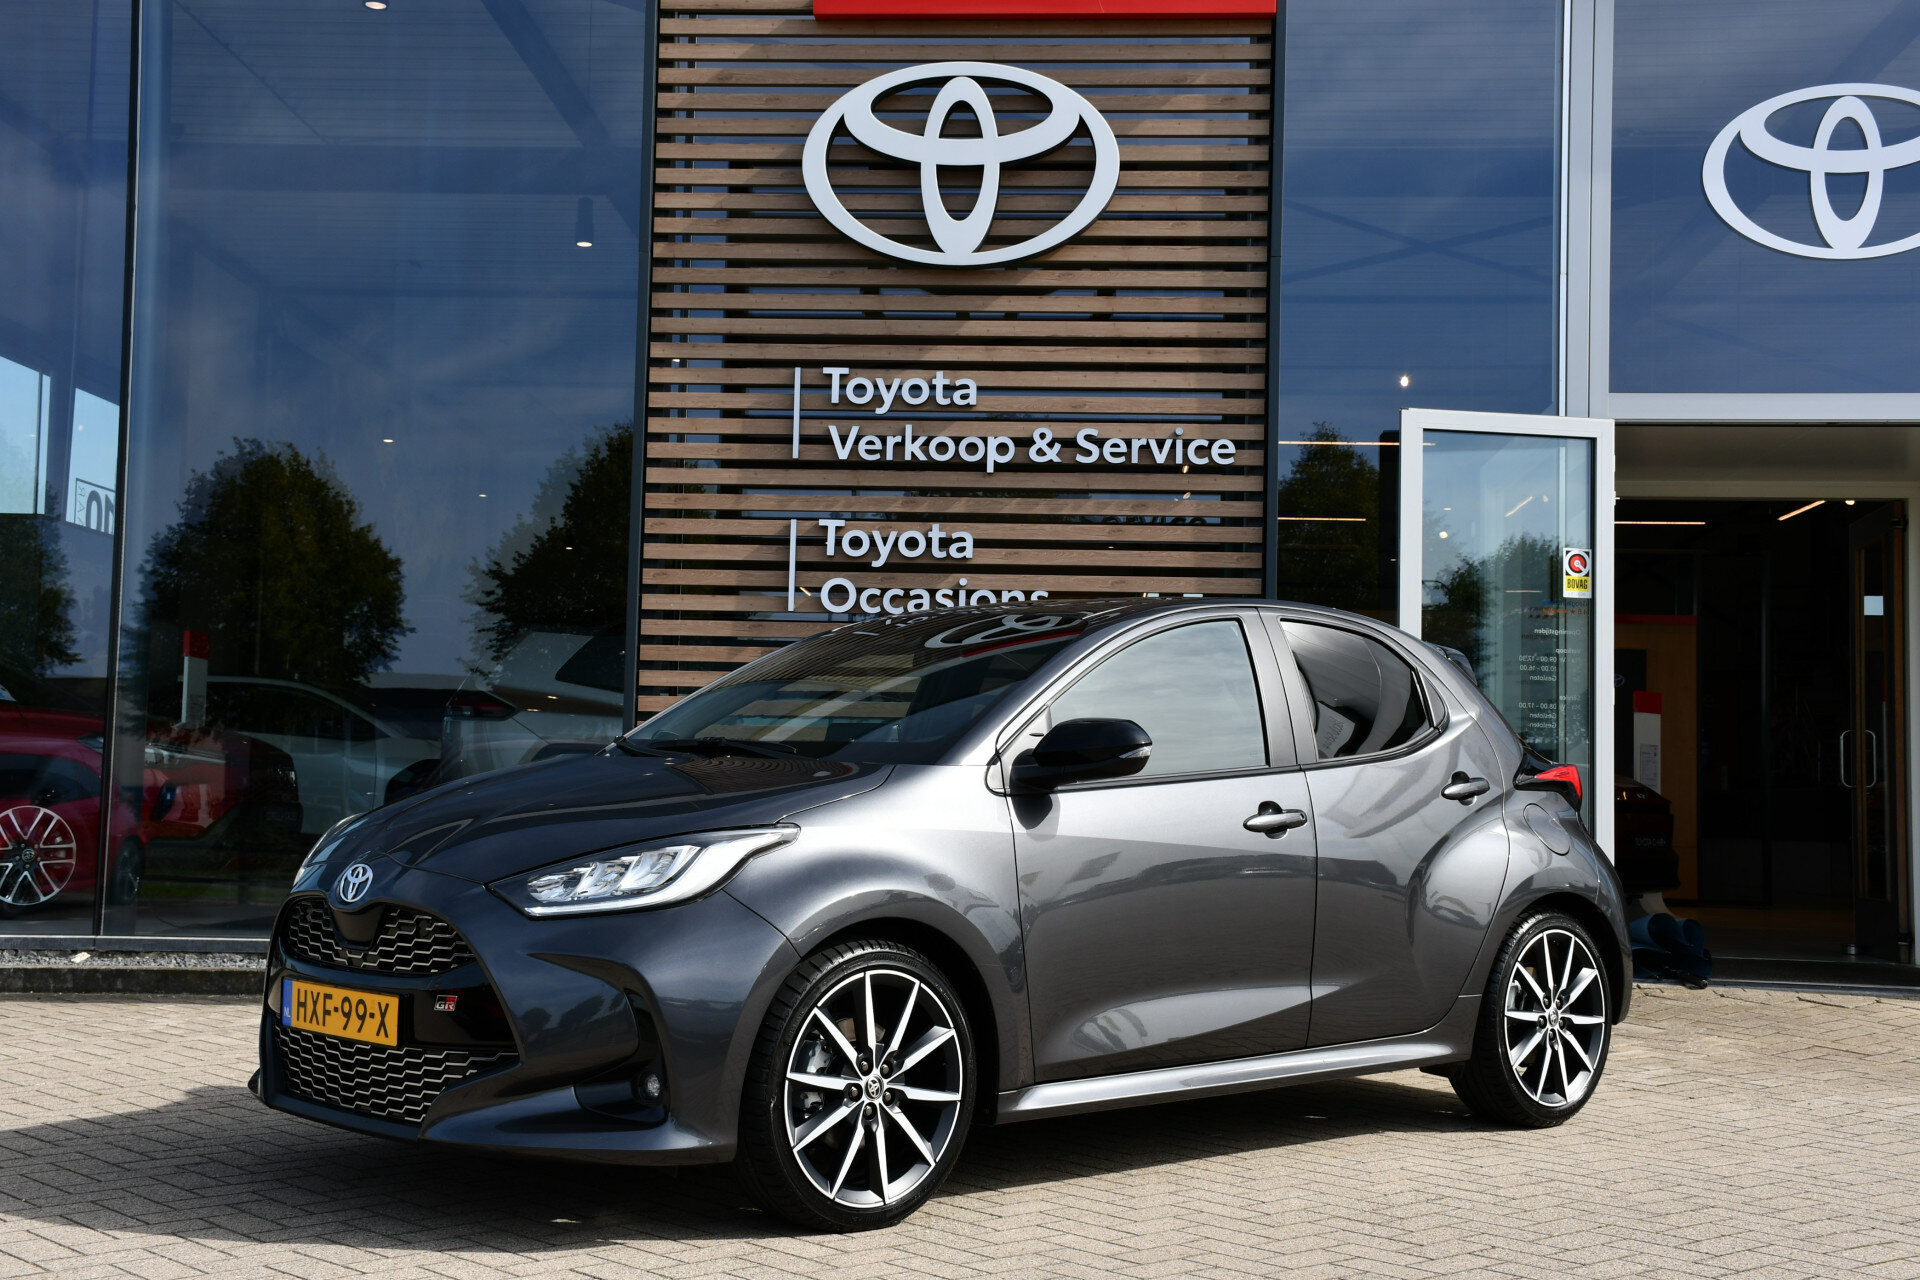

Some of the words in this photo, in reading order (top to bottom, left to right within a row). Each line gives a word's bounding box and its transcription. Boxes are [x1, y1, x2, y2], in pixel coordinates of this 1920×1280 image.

[823, 367, 978, 415] Toyota
[828, 424, 1016, 473] Verkoop
[1028, 427, 1062, 463] &
[1076, 427, 1236, 465] Service
[818, 519, 974, 568] Toyota
[1567, 579, 1587, 589] BOVAG
[283, 1006, 291, 1018] NL
[296, 988, 390, 1038] HXF-99-X
[436, 1001, 455, 1010] GR
